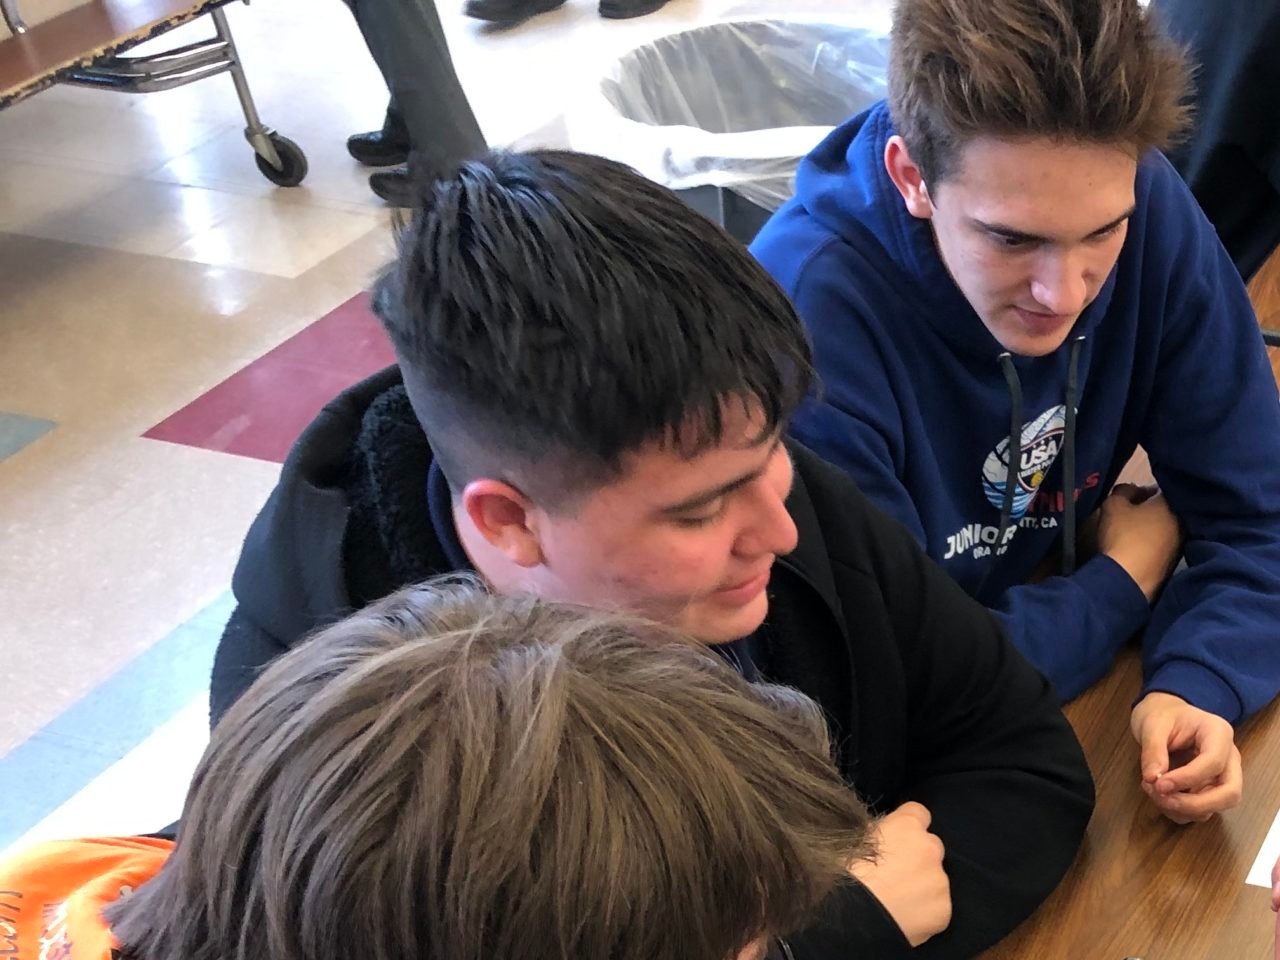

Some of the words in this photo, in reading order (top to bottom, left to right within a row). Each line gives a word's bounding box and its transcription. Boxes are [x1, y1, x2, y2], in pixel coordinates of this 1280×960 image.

[1020, 440, 1057, 470] USA
[1041, 516, 1058, 529] CA
[944, 523, 1017, 560] JUNIOR
